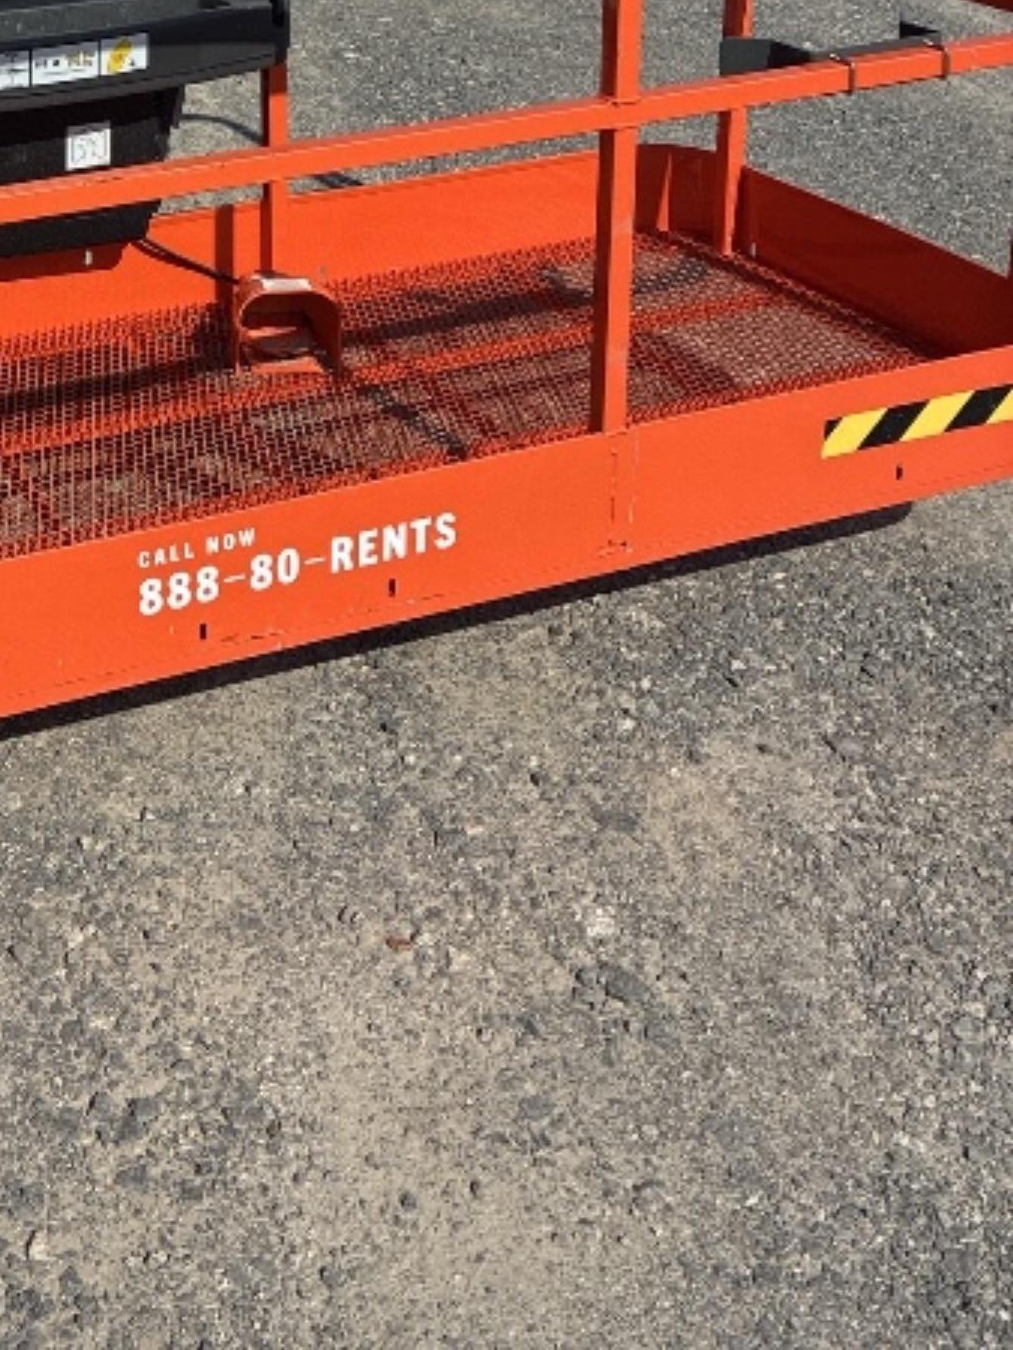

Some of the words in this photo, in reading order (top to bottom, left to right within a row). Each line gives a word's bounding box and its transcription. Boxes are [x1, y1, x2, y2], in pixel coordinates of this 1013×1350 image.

[138, 542, 194, 569] CALL
[206, 527, 256, 555] NOW
[139, 512, 457, 616] 888-80-RENTS
